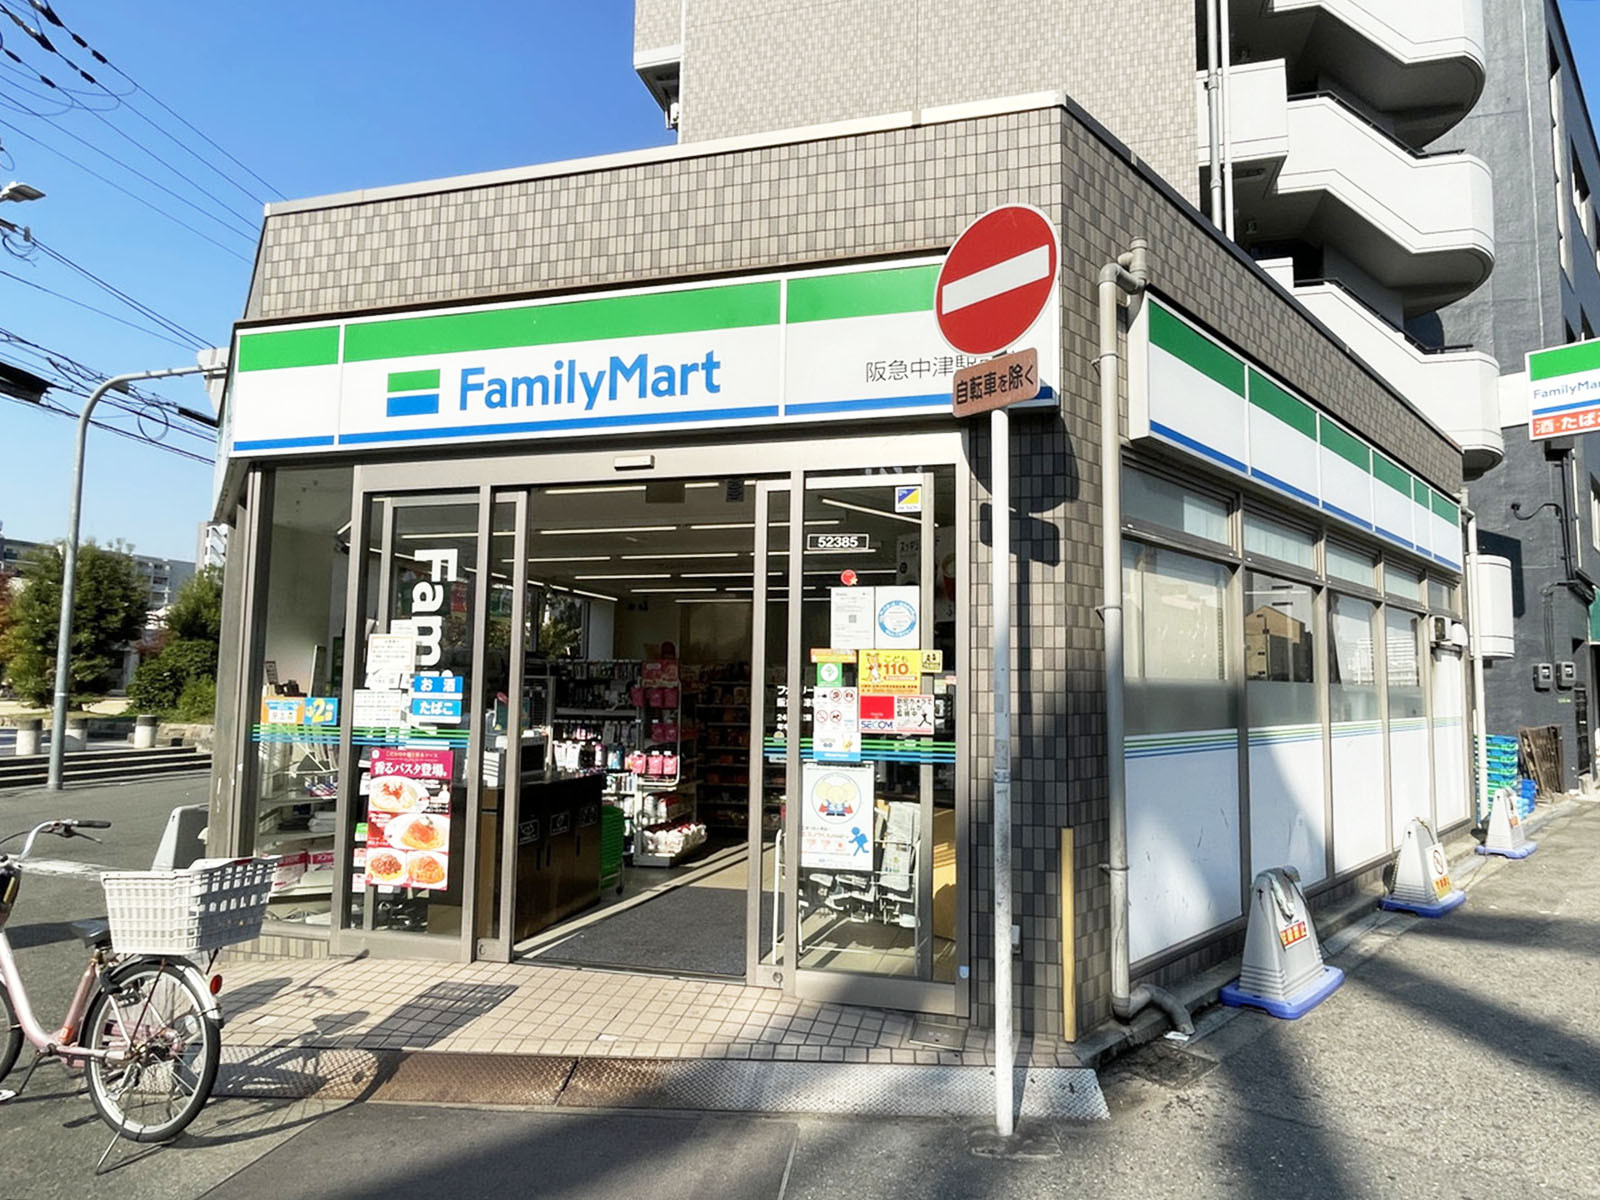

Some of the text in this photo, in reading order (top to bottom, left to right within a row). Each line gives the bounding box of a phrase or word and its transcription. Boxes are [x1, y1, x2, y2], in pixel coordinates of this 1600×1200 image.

[866, 350, 1014, 383] 阪急中津駅
[459, 350, 720, 411] FamilyMart
[956, 363, 1035, 405] 自転車を除く
[1533, 380, 1600, 399] FamilyMa
[1535, 411, 1600, 434] 酒・たば
[818, 536, 859, 548] 52385
[884, 663, 909, 675] 110
[421, 678, 456, 693] お酒
[419, 701, 454, 715] たばこ
[861, 720, 894, 730] SECOM
